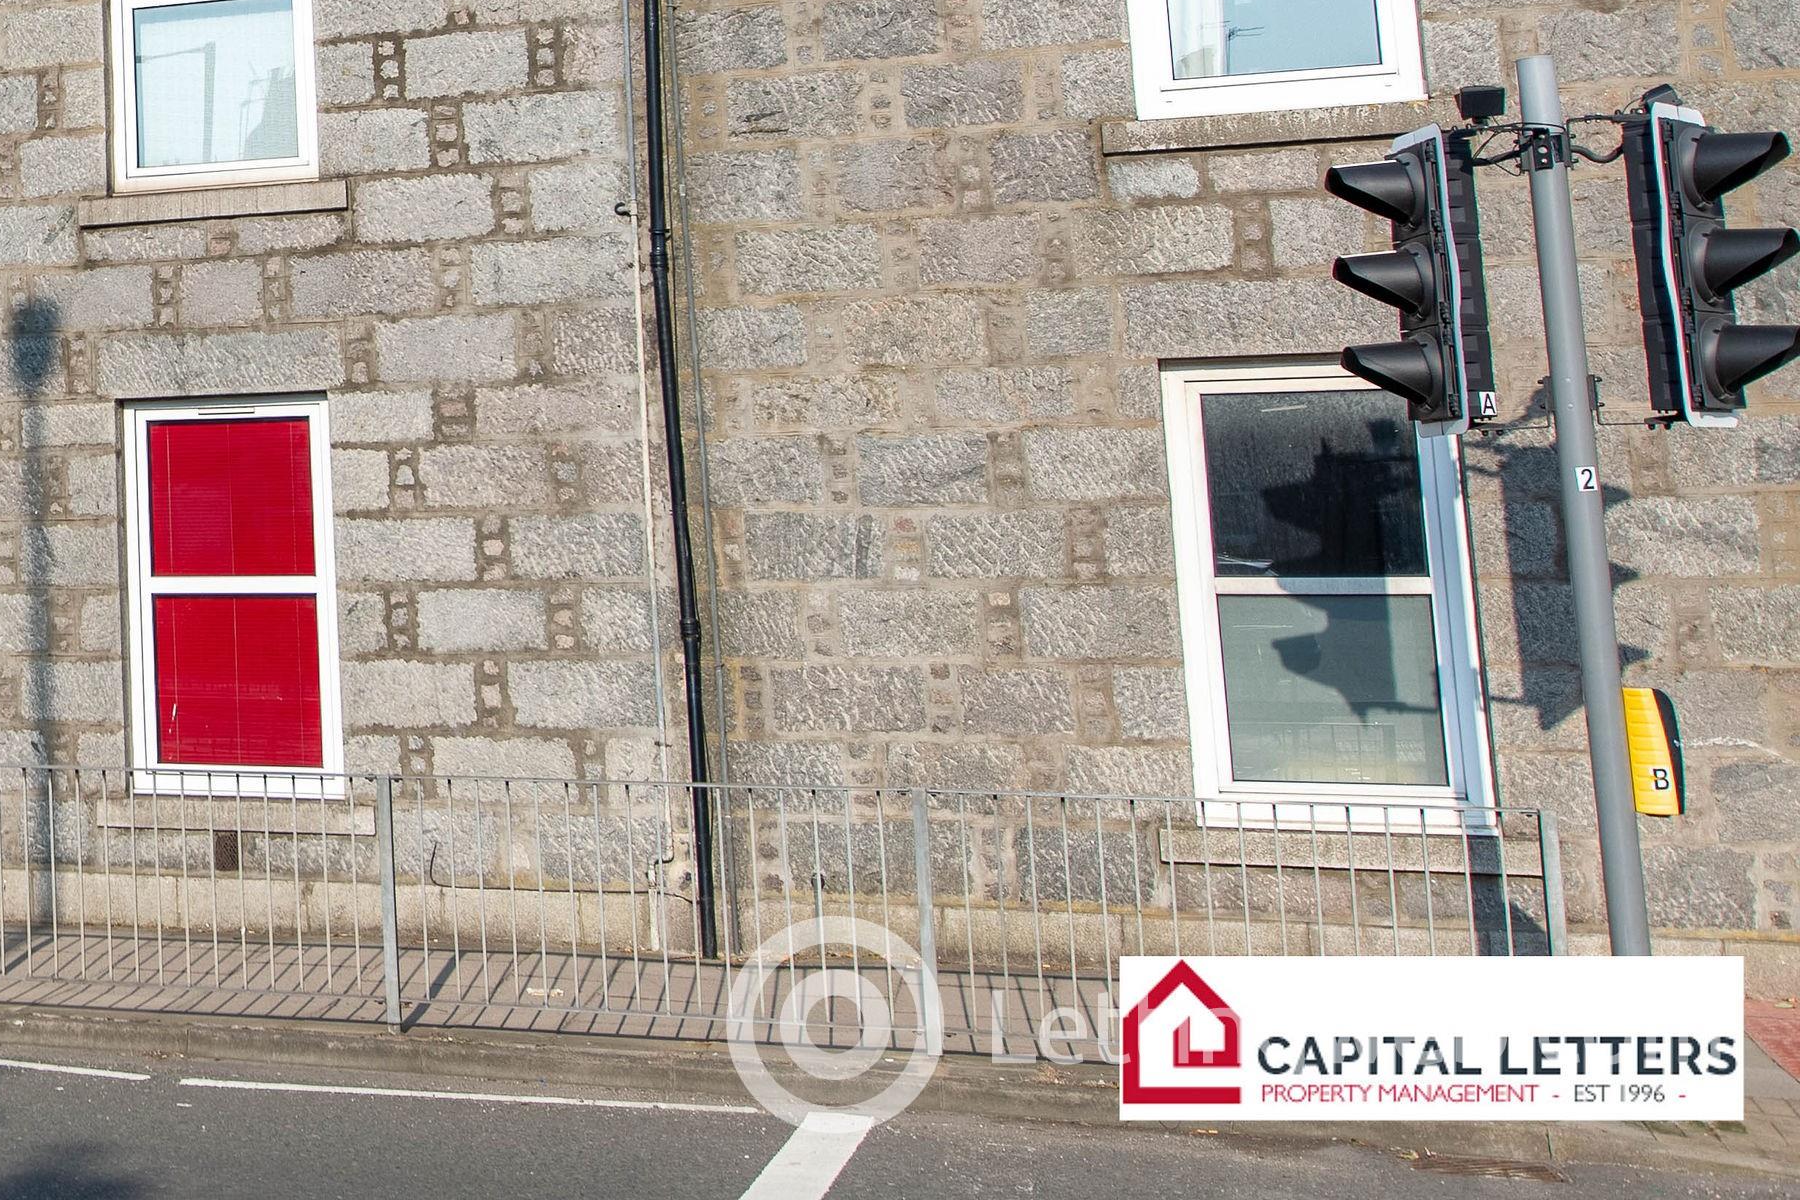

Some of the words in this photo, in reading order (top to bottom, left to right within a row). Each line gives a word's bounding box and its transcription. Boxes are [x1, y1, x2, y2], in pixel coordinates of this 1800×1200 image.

[1483, 393, 1496, 414] A
[1581, 468, 1595, 490] 2
[1652, 768, 1669, 791] B
